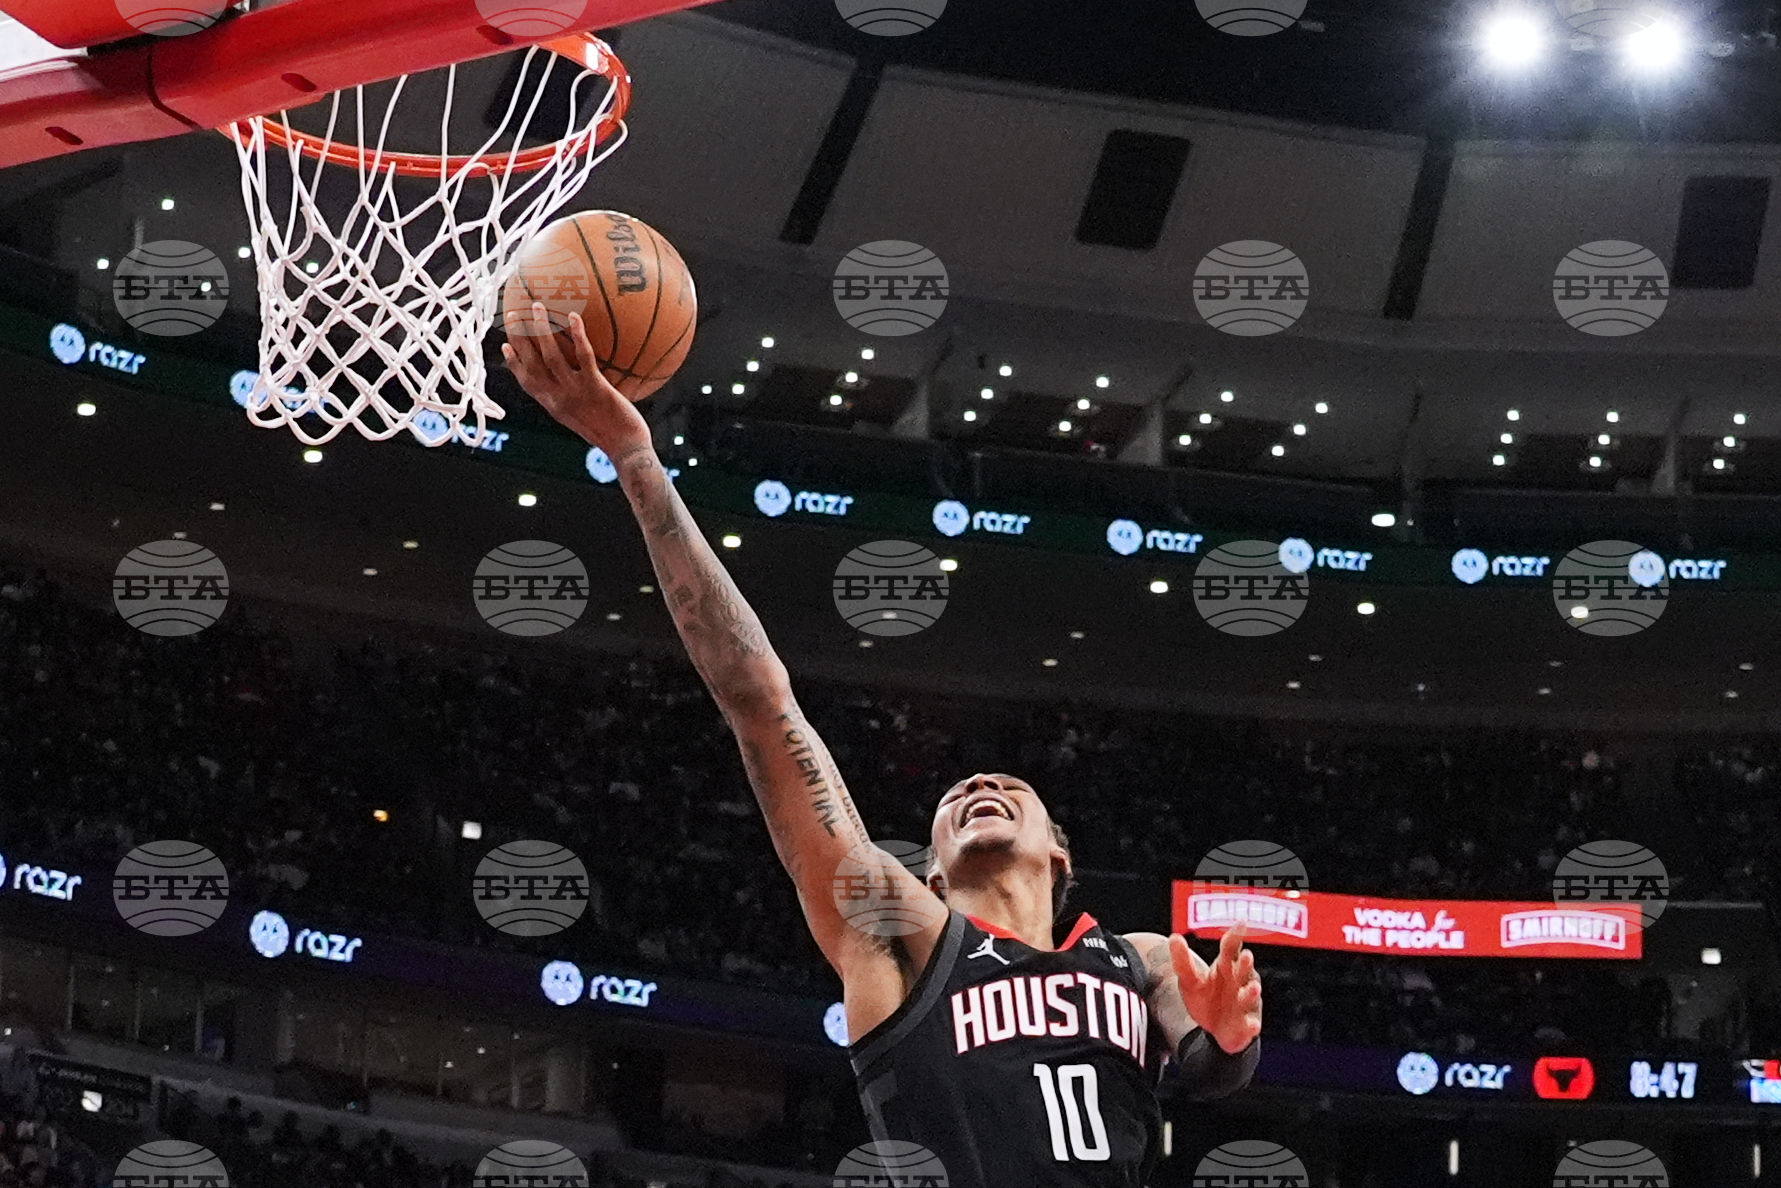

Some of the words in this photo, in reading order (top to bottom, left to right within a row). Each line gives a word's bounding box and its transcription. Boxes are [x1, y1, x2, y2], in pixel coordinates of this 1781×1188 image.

[88, 341, 146, 375] razr
[794, 490, 854, 515] razr
[973, 511, 1031, 534] razr
[1146, 529, 1203, 553] razr
[1317, 547, 1373, 571] razr
[1491, 555, 1550, 577] razr
[1668, 558, 1727, 580] razr
[13, 863, 82, 900] razr
[1353, 907, 1427, 930] VODKA
[1508, 916, 1619, 941] SMIRNOFF
[295, 928, 363, 963] razr
[1341, 925, 1382, 947] THE
[1385, 929, 1465, 949] PEOPLE
[589, 975, 658, 1007] razr
[952, 971, 1149, 1069] HOUSTON
[1444, 1062, 1512, 1090] razr
[1033, 1062, 1111, 1162] 10
